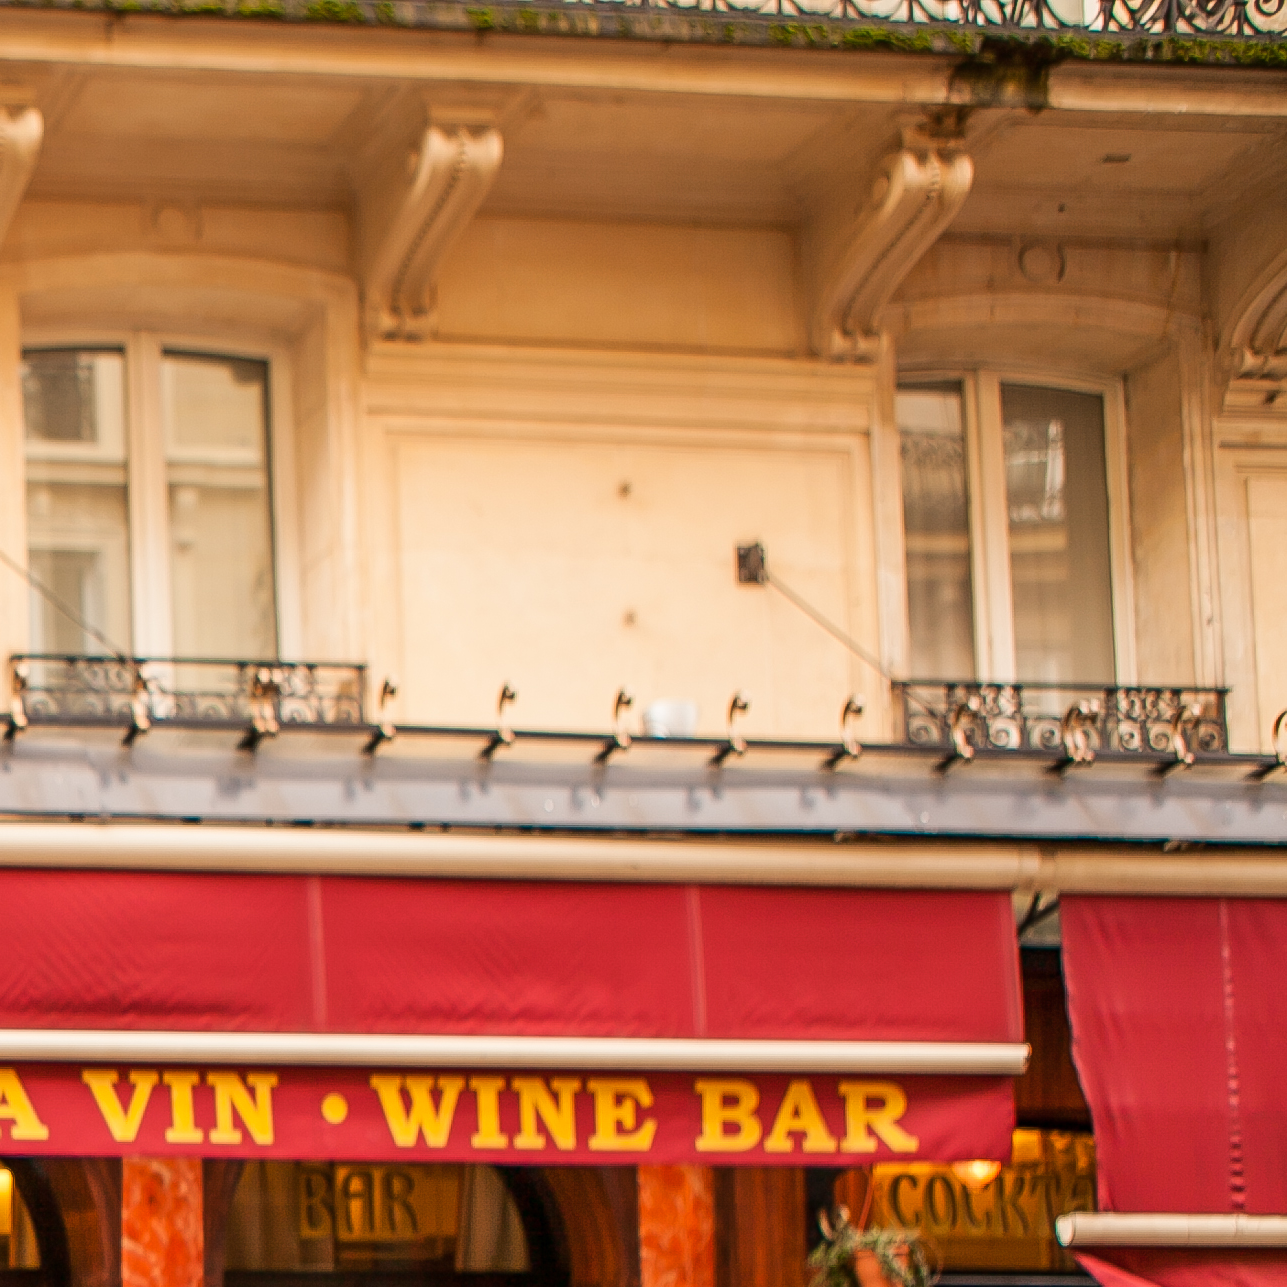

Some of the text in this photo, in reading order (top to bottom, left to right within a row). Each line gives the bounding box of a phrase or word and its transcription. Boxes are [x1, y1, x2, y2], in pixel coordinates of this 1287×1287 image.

[82, 1070, 278, 1147] VIN
[370, 1074, 657, 1152] WINE
[694, 1080, 920, 1154] BAR
[303, 1169, 419, 1233] BAR
